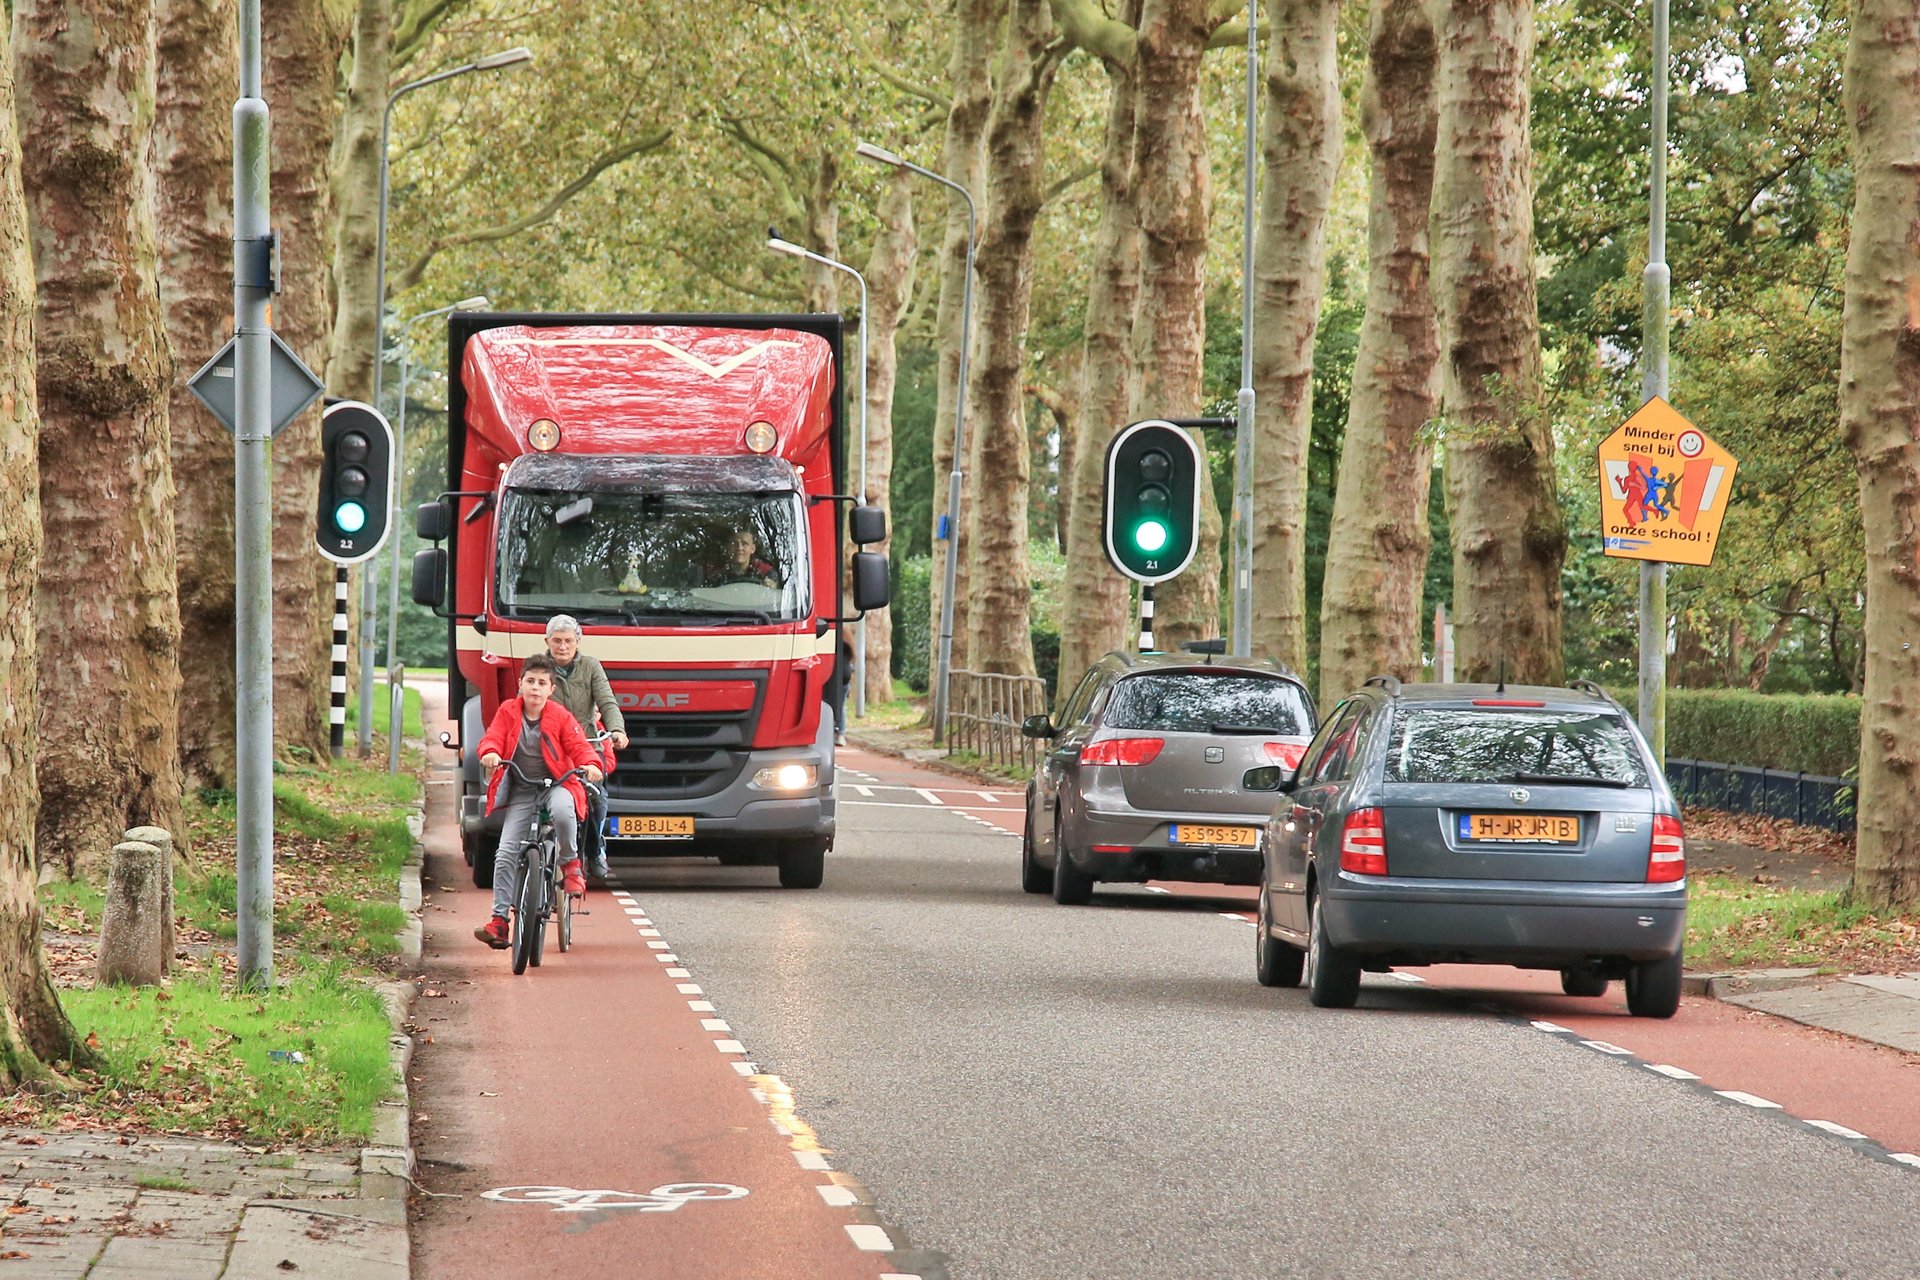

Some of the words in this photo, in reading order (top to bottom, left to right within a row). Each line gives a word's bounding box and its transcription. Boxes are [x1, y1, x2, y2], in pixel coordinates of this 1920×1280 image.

[1624, 426, 1675, 441] Minder
[1623, 442, 1653, 454] snel
[1657, 443, 1676, 458] bij
[1611, 524, 1647, 537] onze
[1651, 527, 1702, 542] school
[615, 693, 690, 708] DAF
[624, 819, 687, 832] 88-BJL-4
